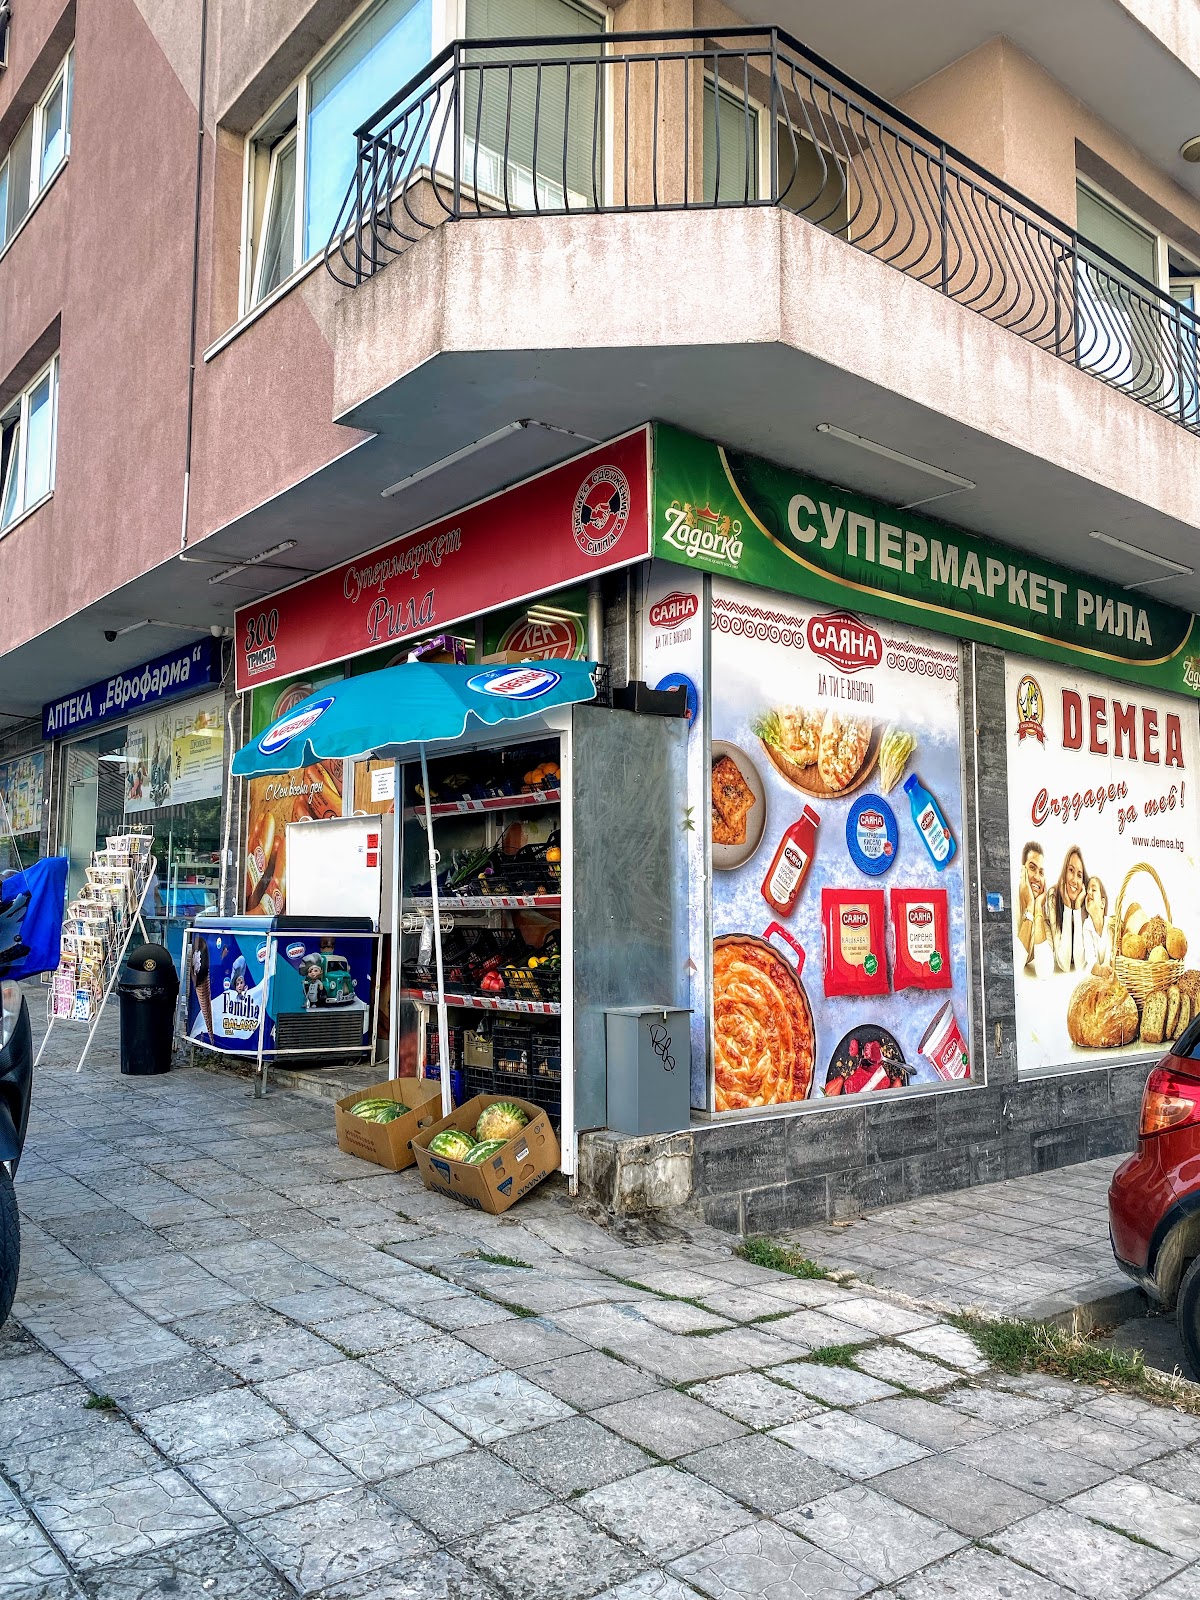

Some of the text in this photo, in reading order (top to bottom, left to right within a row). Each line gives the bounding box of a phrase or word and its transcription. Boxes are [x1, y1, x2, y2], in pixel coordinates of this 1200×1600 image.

[587, 533, 616, 554] СИЛА
[662, 507, 744, 565] Zagorka
[343, 527, 462, 603] Супермаркет
[788, 494, 1153, 646] СУПЕРМАРКЕТ РИЛА
[366, 588, 436, 643] Рила
[652, 598, 695, 623] САЯНА
[244, 608, 279, 652] 300
[812, 622, 878, 660] САЯНА
[246, 645, 277, 669] ТРИСТА
[818, 673, 874, 704] ДА ТИ Е ВКУСНО
[1183, 660, 1200, 690] Zag
[47, 692, 93, 732] АПТЕКА
[1060, 688, 1186, 769] DEMEA
[309, 781, 324, 805] ден
[1031, 780, 1129, 827] Създаден
[1117, 780, 1186, 835] за теб!
[860, 816, 883, 825] САЯНА
[1131, 835, 1185, 853] www.demea.bg
[843, 913, 867, 923] САЯНА
[909, 912, 931, 922] САЯНА
[222, 992, 260, 1019] Familia
[223, 1017, 258, 1031] GALAXY
